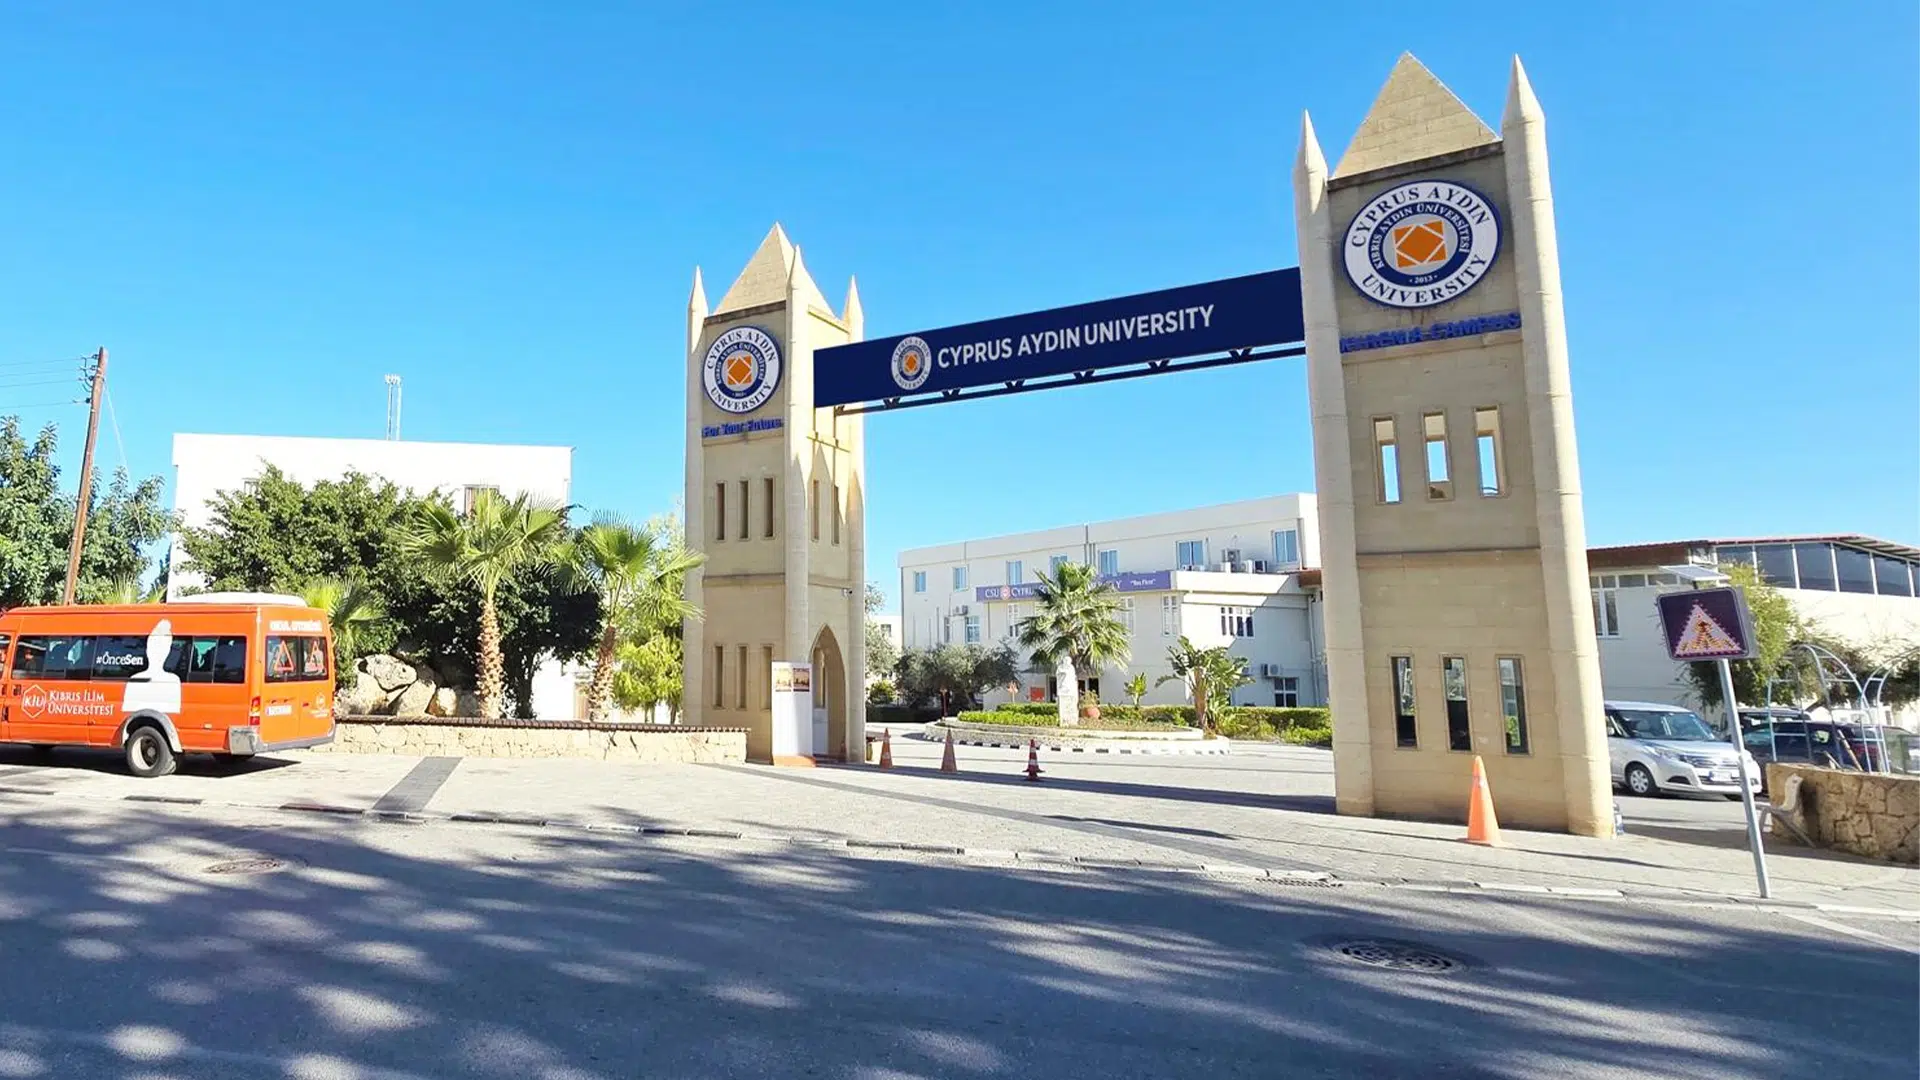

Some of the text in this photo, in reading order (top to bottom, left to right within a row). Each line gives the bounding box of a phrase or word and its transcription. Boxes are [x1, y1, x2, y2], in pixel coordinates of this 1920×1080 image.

[1352, 187, 1490, 247] CYPRUS AYDIN
[1371, 234, 1385, 269] KIBRIS
[1381, 207, 1413, 233] AYDIN
[1362, 254, 1487, 304] UNIVERSITY
[1414, 275, 1433, 284] 2013
[707, 331, 776, 369] CYPRUS AYDIN
[937, 337, 1012, 369] CYPRUS
[1017, 326, 1080, 357] AYDIN
[1084, 304, 1215, 346] UNIVERSITY
[710, 382, 772, 410] UNIVERSITY
[985, 587, 999, 598] CSU
